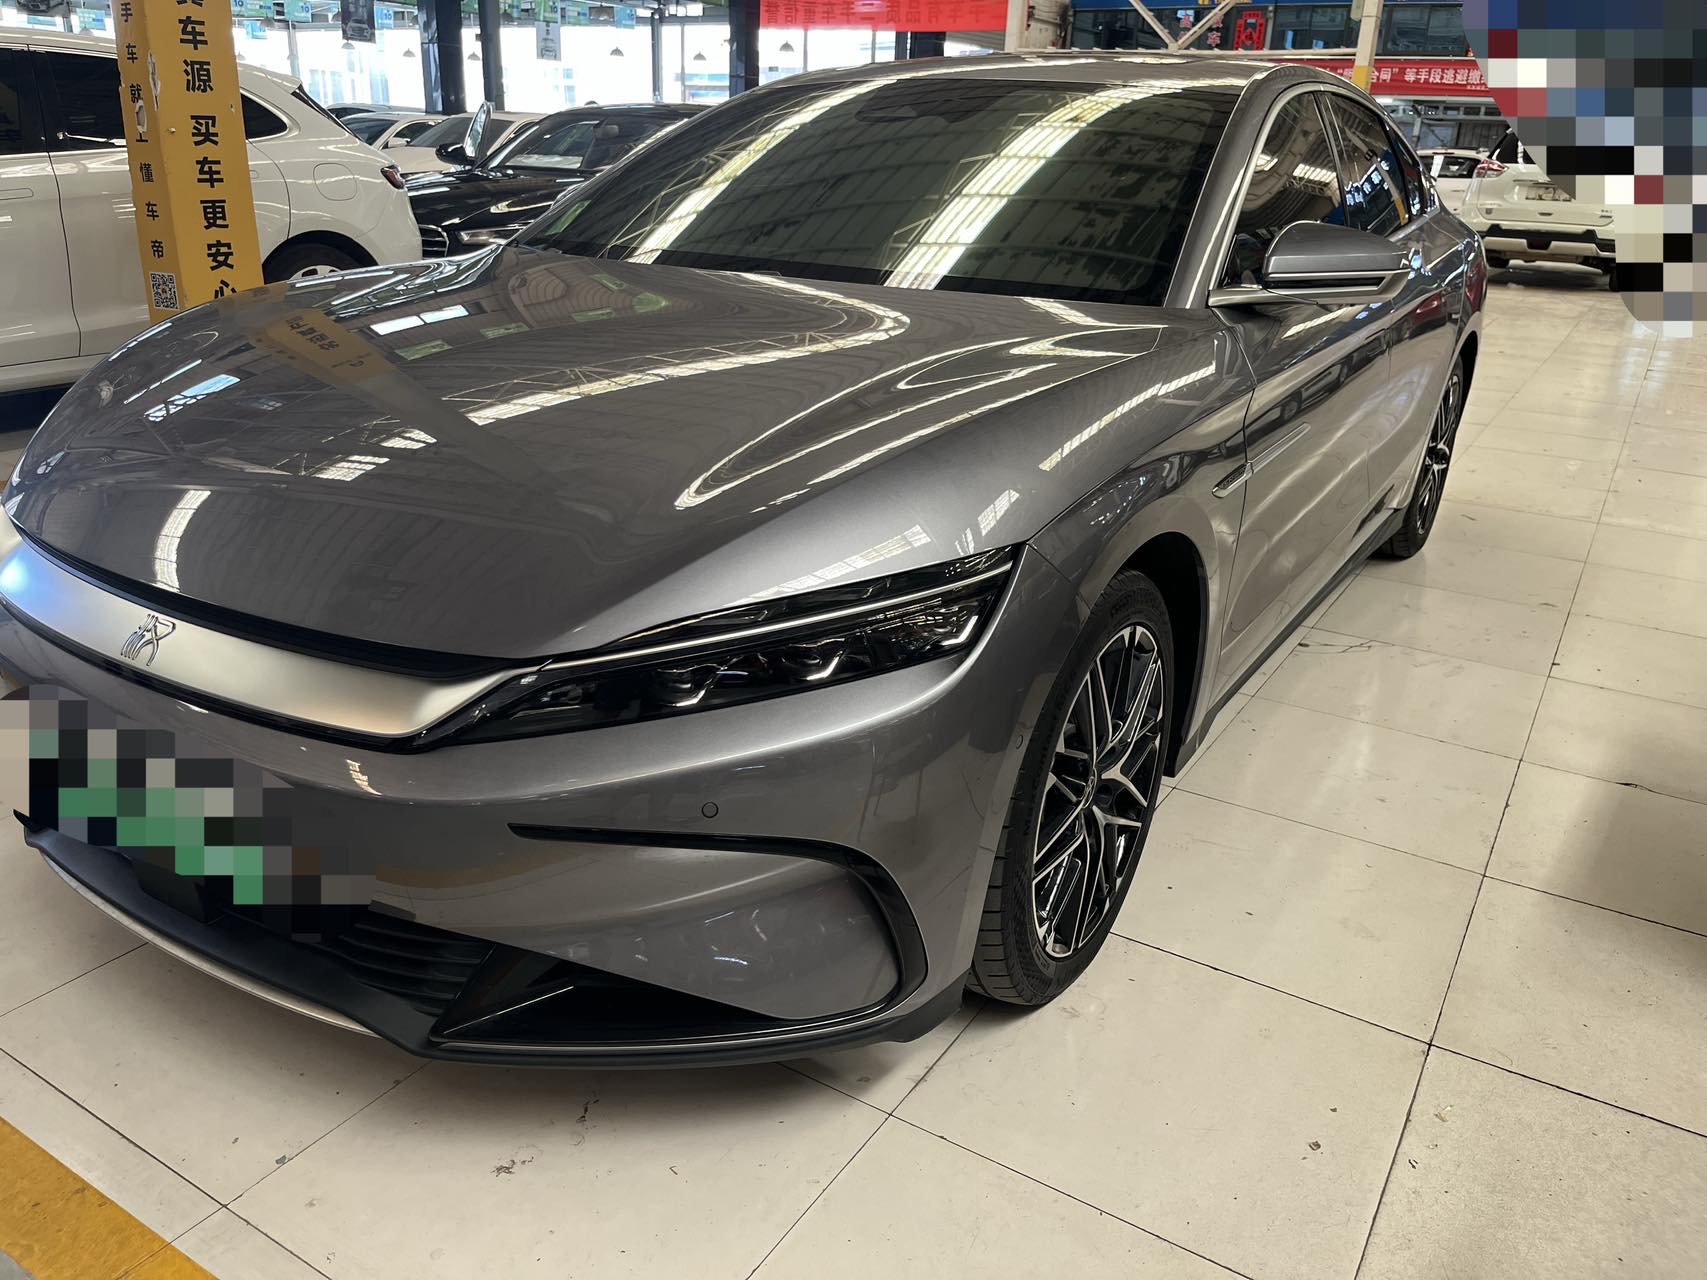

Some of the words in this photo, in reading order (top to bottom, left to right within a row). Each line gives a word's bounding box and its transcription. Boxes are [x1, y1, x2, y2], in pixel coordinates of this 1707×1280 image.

[177, 0, 214, 93] 车源
[190, 115, 237, 299] 买车更安心
